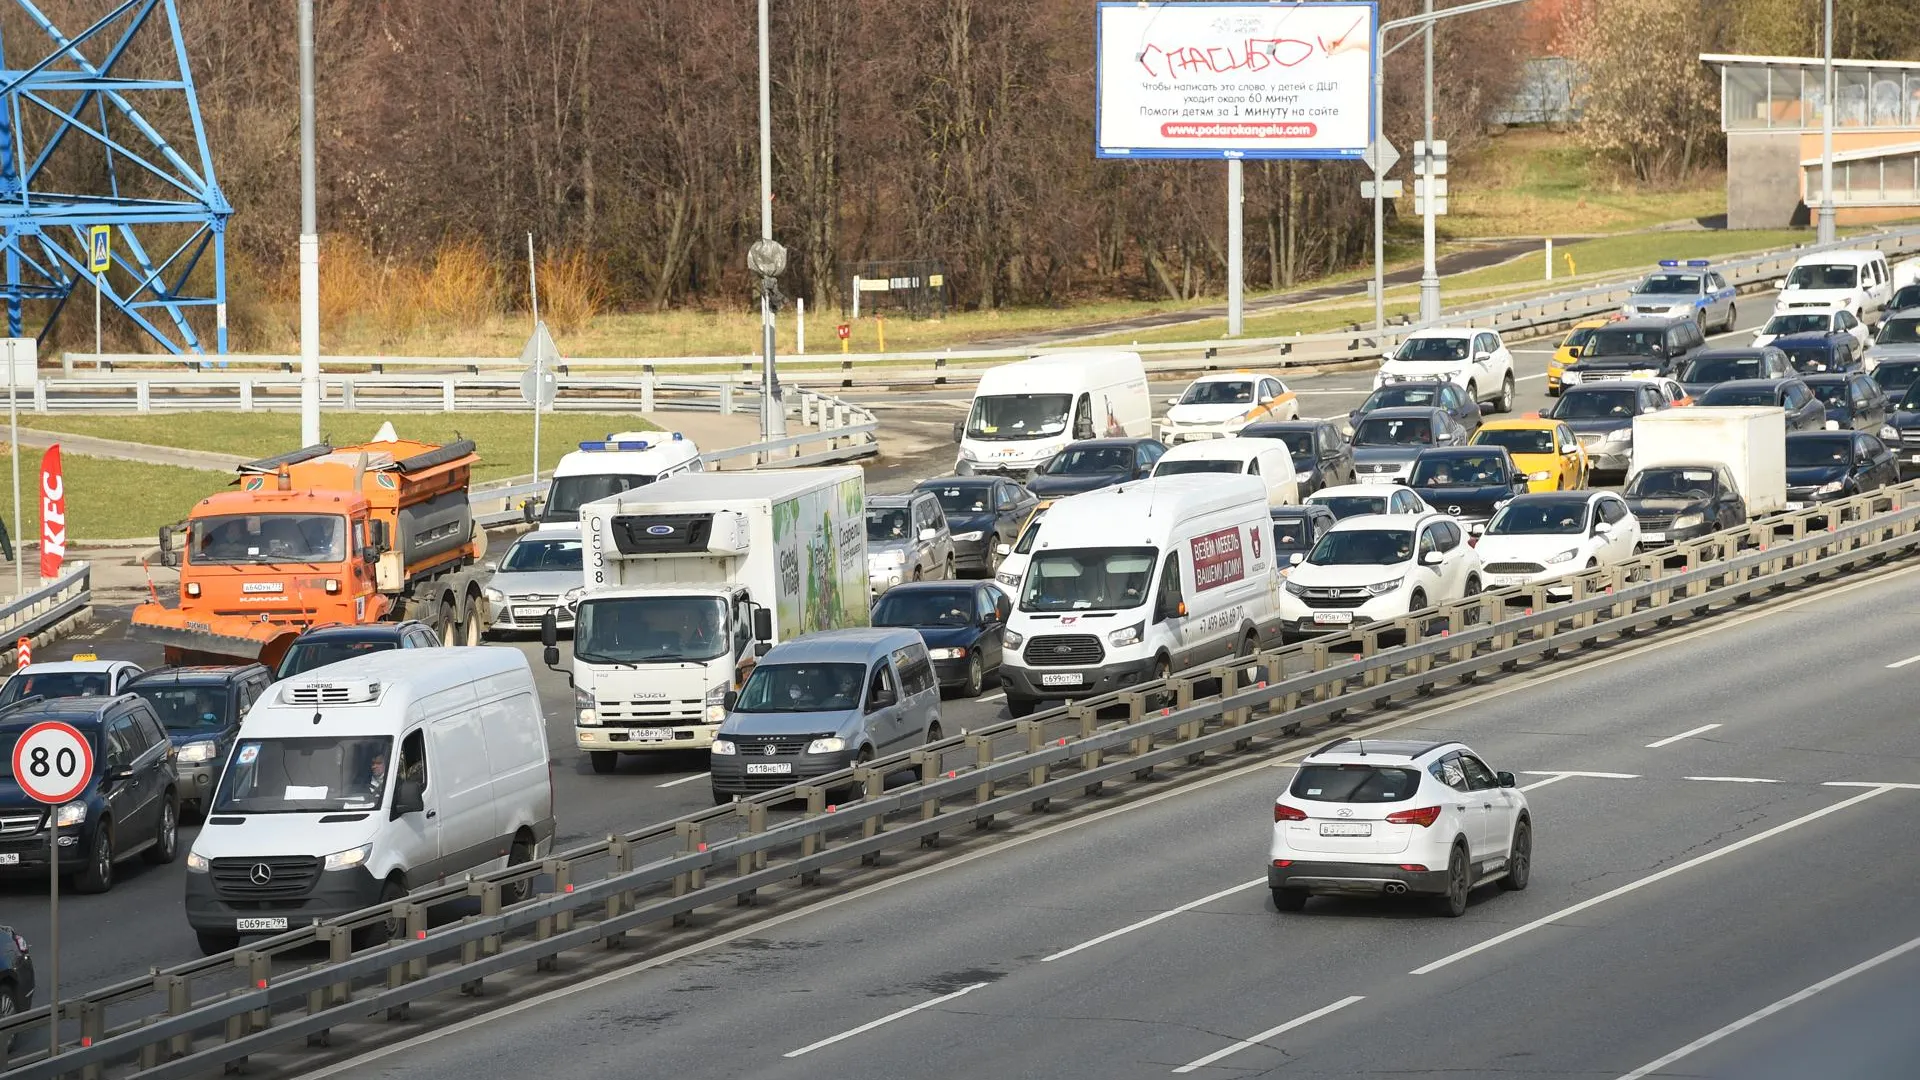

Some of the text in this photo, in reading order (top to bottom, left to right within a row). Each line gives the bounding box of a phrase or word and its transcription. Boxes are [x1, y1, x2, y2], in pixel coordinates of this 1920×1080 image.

[1142, 82, 1171, 91] Чтобы
[1270, 84, 1276, 92] у
[1278, 82, 1306, 91] детей
[1316, 82, 1338, 91] ДЦП
[1183, 93, 1298, 104] уходит около 60 минут
[1140, 105, 1339, 119] Помоги детям за 1 минуту на сайте
[1166, 124, 1311, 137] www.podarokangelu.com
[43, 471, 65, 558] KFC
[1215, 534, 1240, 556] МЕБЕЛЬ
[1197, 562, 1223, 585] ВАШЕМУ
[1208, 616, 1218, 630] 499
[30, 747, 76, 777] 80
[239, 919, 271, 929] Е069РЕ
